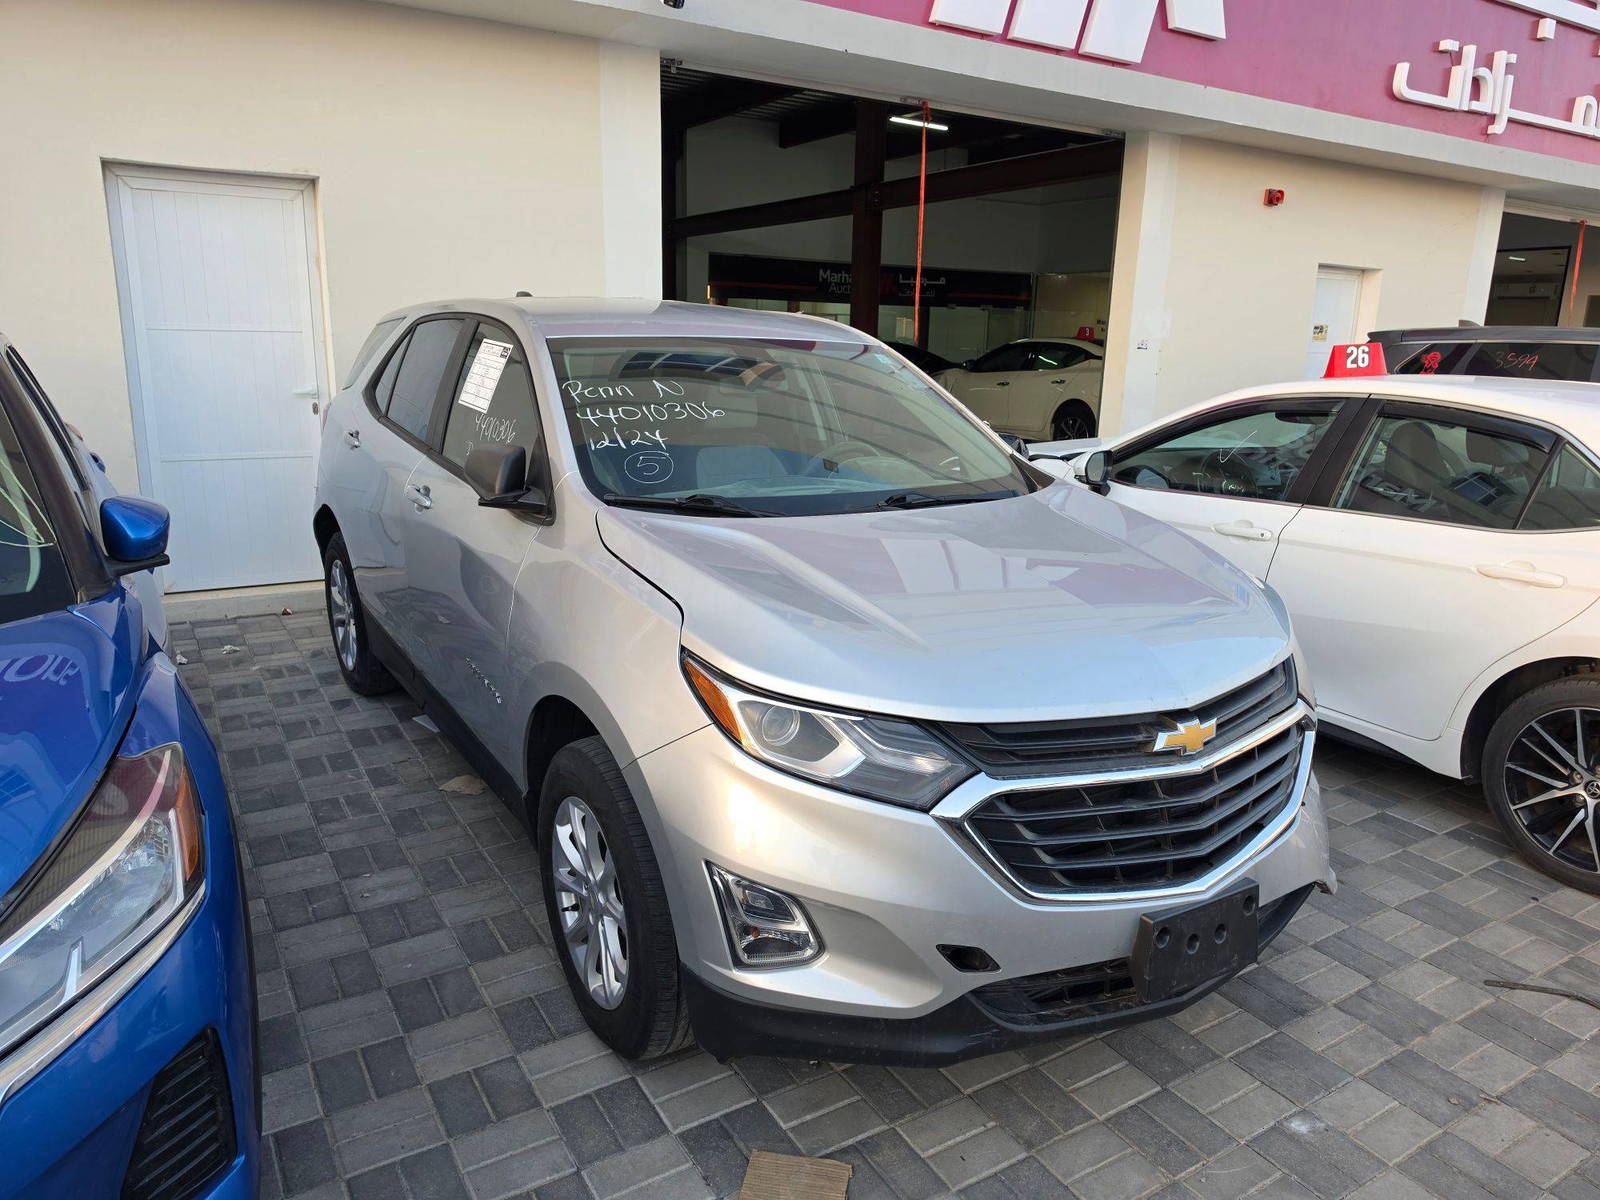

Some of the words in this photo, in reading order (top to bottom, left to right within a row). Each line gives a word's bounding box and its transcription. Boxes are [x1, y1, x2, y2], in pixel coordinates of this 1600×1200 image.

[1346, 345, 1370, 369] 26
[652, 379, 685, 398] N
[576, 401, 726, 427] 44010306
